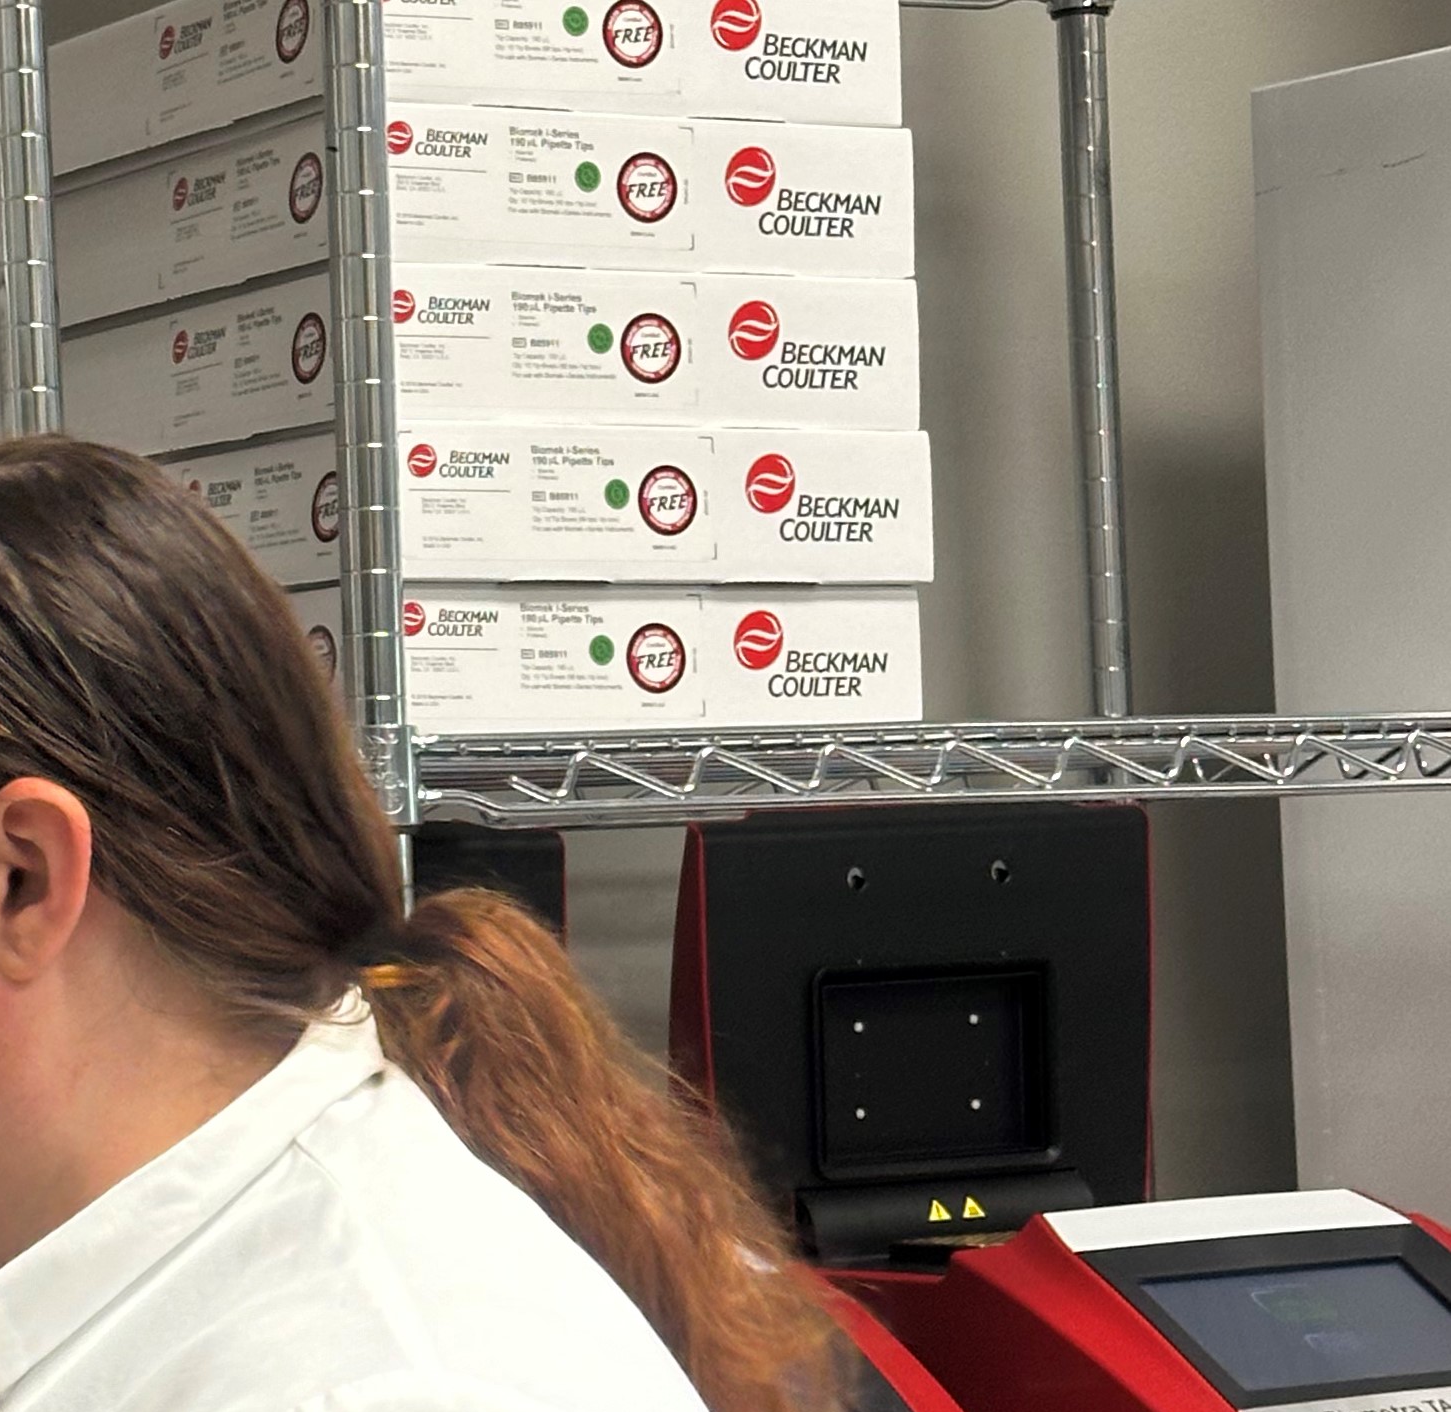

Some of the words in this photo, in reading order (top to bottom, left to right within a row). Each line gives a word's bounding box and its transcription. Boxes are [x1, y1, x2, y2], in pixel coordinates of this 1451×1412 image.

[612, 25, 654, 44] FREE
[762, 33, 867, 62] BECKMAN
[744, 56, 840, 84] COULTER
[426, 128, 488, 147] BECKMAN
[414, 141, 471, 159] COULTER
[626, 181, 668, 199] FREE
[776, 188, 882, 216] BECKMAN
[758, 211, 854, 239] COULTER
[428, 296, 490, 312] BECKMAN
[417, 310, 474, 325] COULTER
[630, 341, 671, 360] FREE
[780, 342, 886, 366] BECKMAN
[762, 365, 858, 390] COULTER
[449, 449, 510, 464] BECKMAN
[438, 463, 495, 479] COULTER
[648, 492, 689, 512] FREE
[796, 494, 900, 519] BECKMAN
[779, 517, 874, 543] COULTER
[438, 608, 499, 623] BECKMAN
[427, 622, 483, 637] COULTER
[635, 650, 678, 669] FREE
[785, 650, 888, 674] BECKMAN
[768, 673, 862, 699] COULTER
